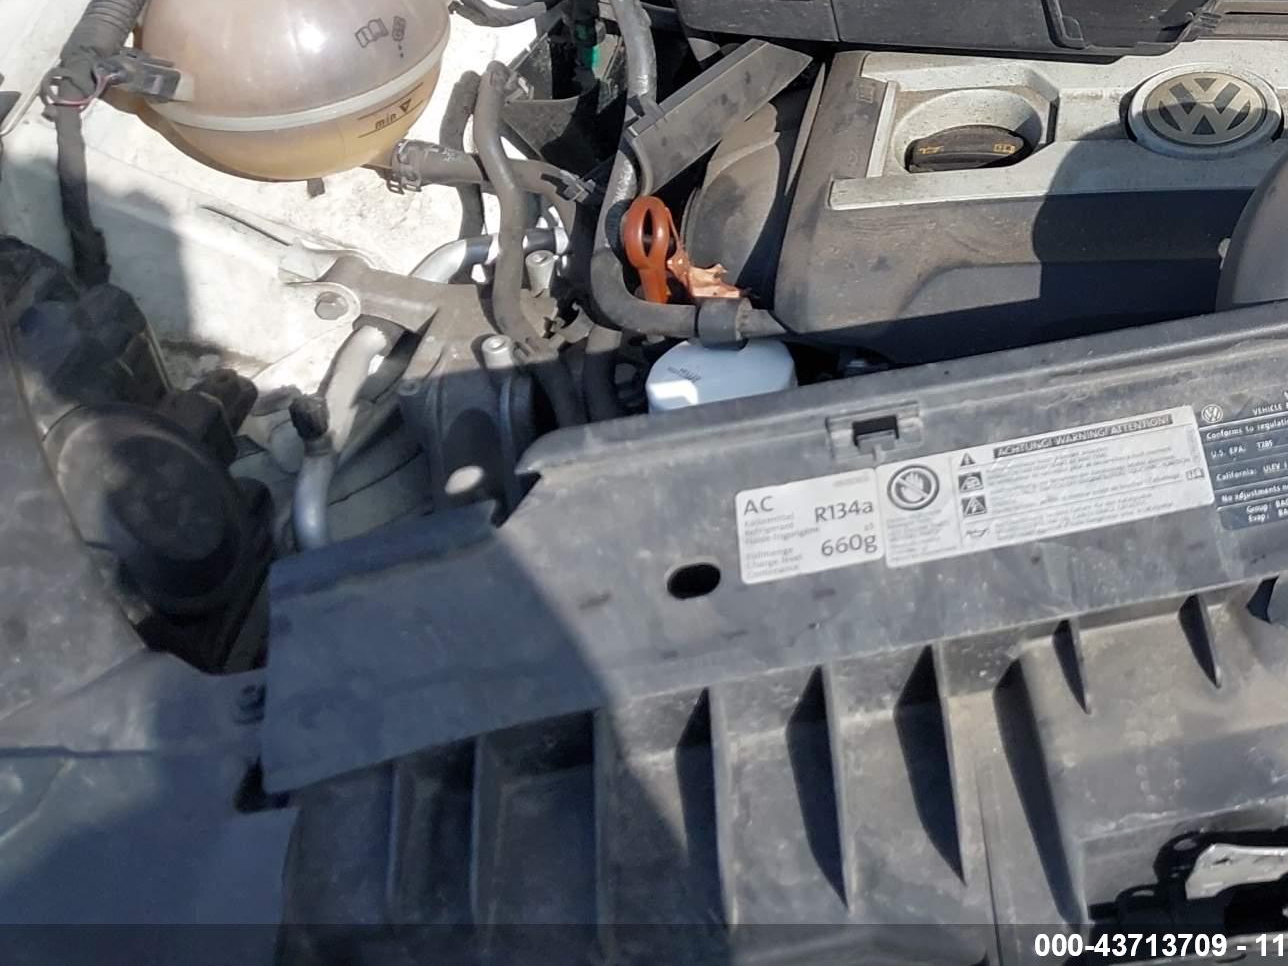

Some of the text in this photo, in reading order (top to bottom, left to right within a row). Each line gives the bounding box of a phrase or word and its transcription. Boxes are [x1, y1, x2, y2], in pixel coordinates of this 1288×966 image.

[1252, 403, 1283, 416] VEHICLE
[1055, 428, 1109, 446] WARNING!
[1110, 415, 1171, 436] ATTENTION!
[1206, 427, 1243, 440] Conforms
[1245, 425, 1254, 433] to
[1216, 468, 1257, 481] California:
[1221, 494, 1233, 503] No
[1234, 483, 1281, 500] adjustments
[743, 495, 774, 516] AC
[814, 499, 874, 523] R134a
[821, 533, 878, 556] 660g
